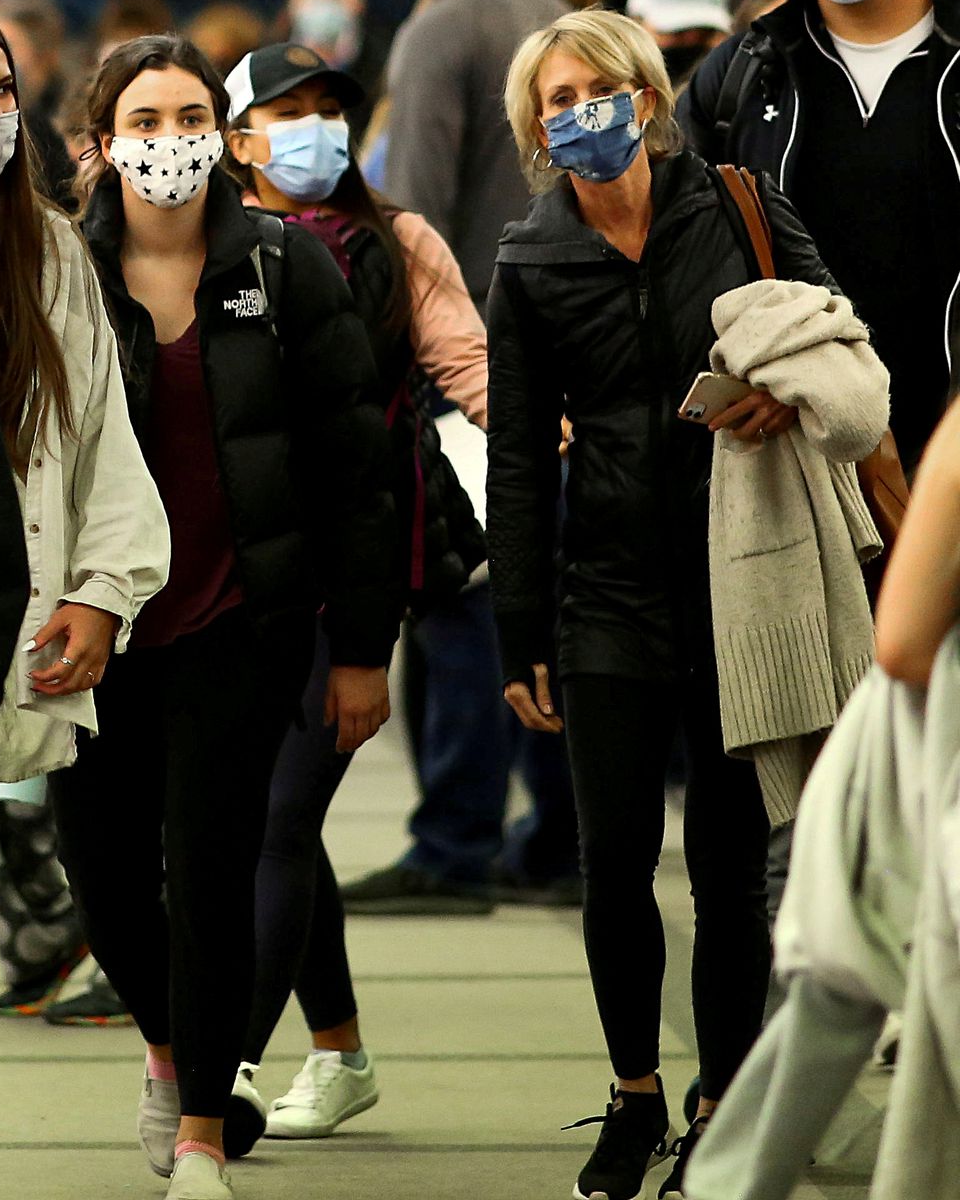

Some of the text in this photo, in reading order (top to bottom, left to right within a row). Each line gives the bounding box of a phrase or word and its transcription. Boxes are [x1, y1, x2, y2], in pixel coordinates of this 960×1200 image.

[238, 289, 258, 300] THE
[223, 299, 257, 310] NORTH
[235, 307, 258, 318] FACE
